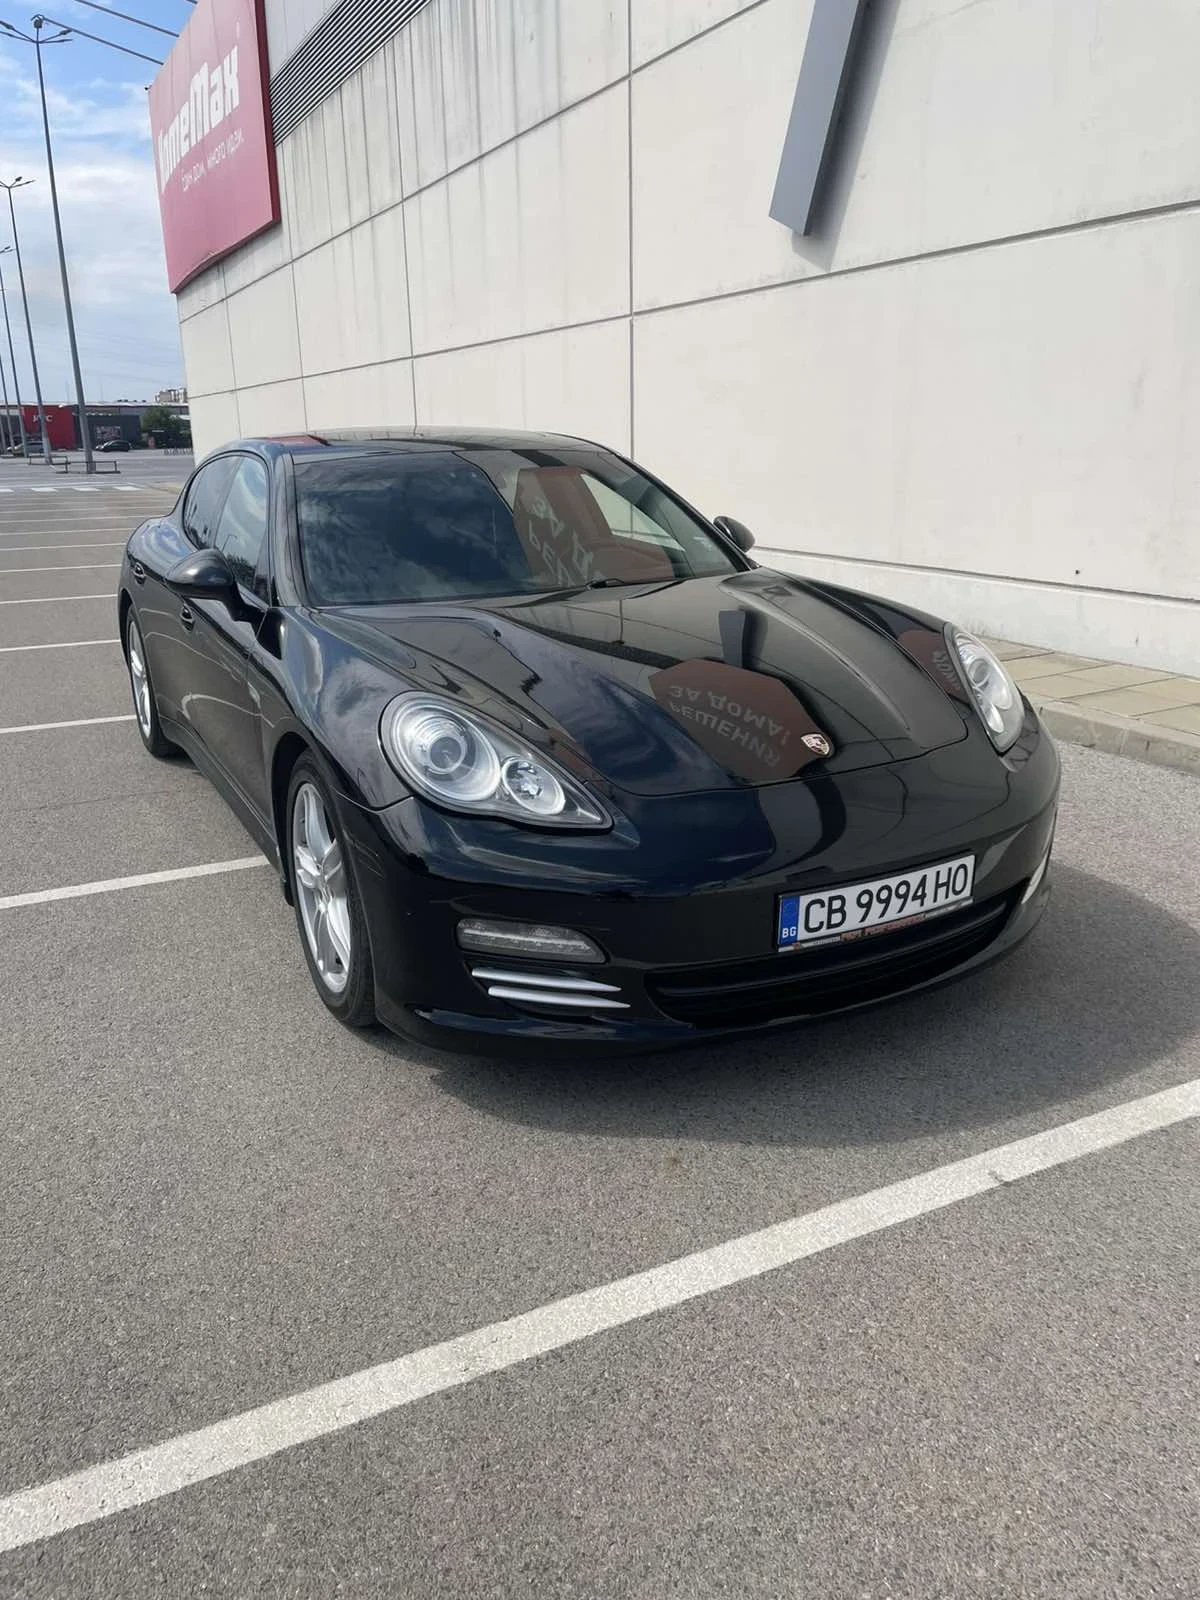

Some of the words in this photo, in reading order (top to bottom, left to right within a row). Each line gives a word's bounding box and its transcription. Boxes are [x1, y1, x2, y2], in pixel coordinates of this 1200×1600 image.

[32, 414, 53, 423] KC
[803, 894, 847, 934] CB
[855, 873, 928, 924] 9994
[932, 863, 969, 904] HO
[781, 926, 797, 939] BG
